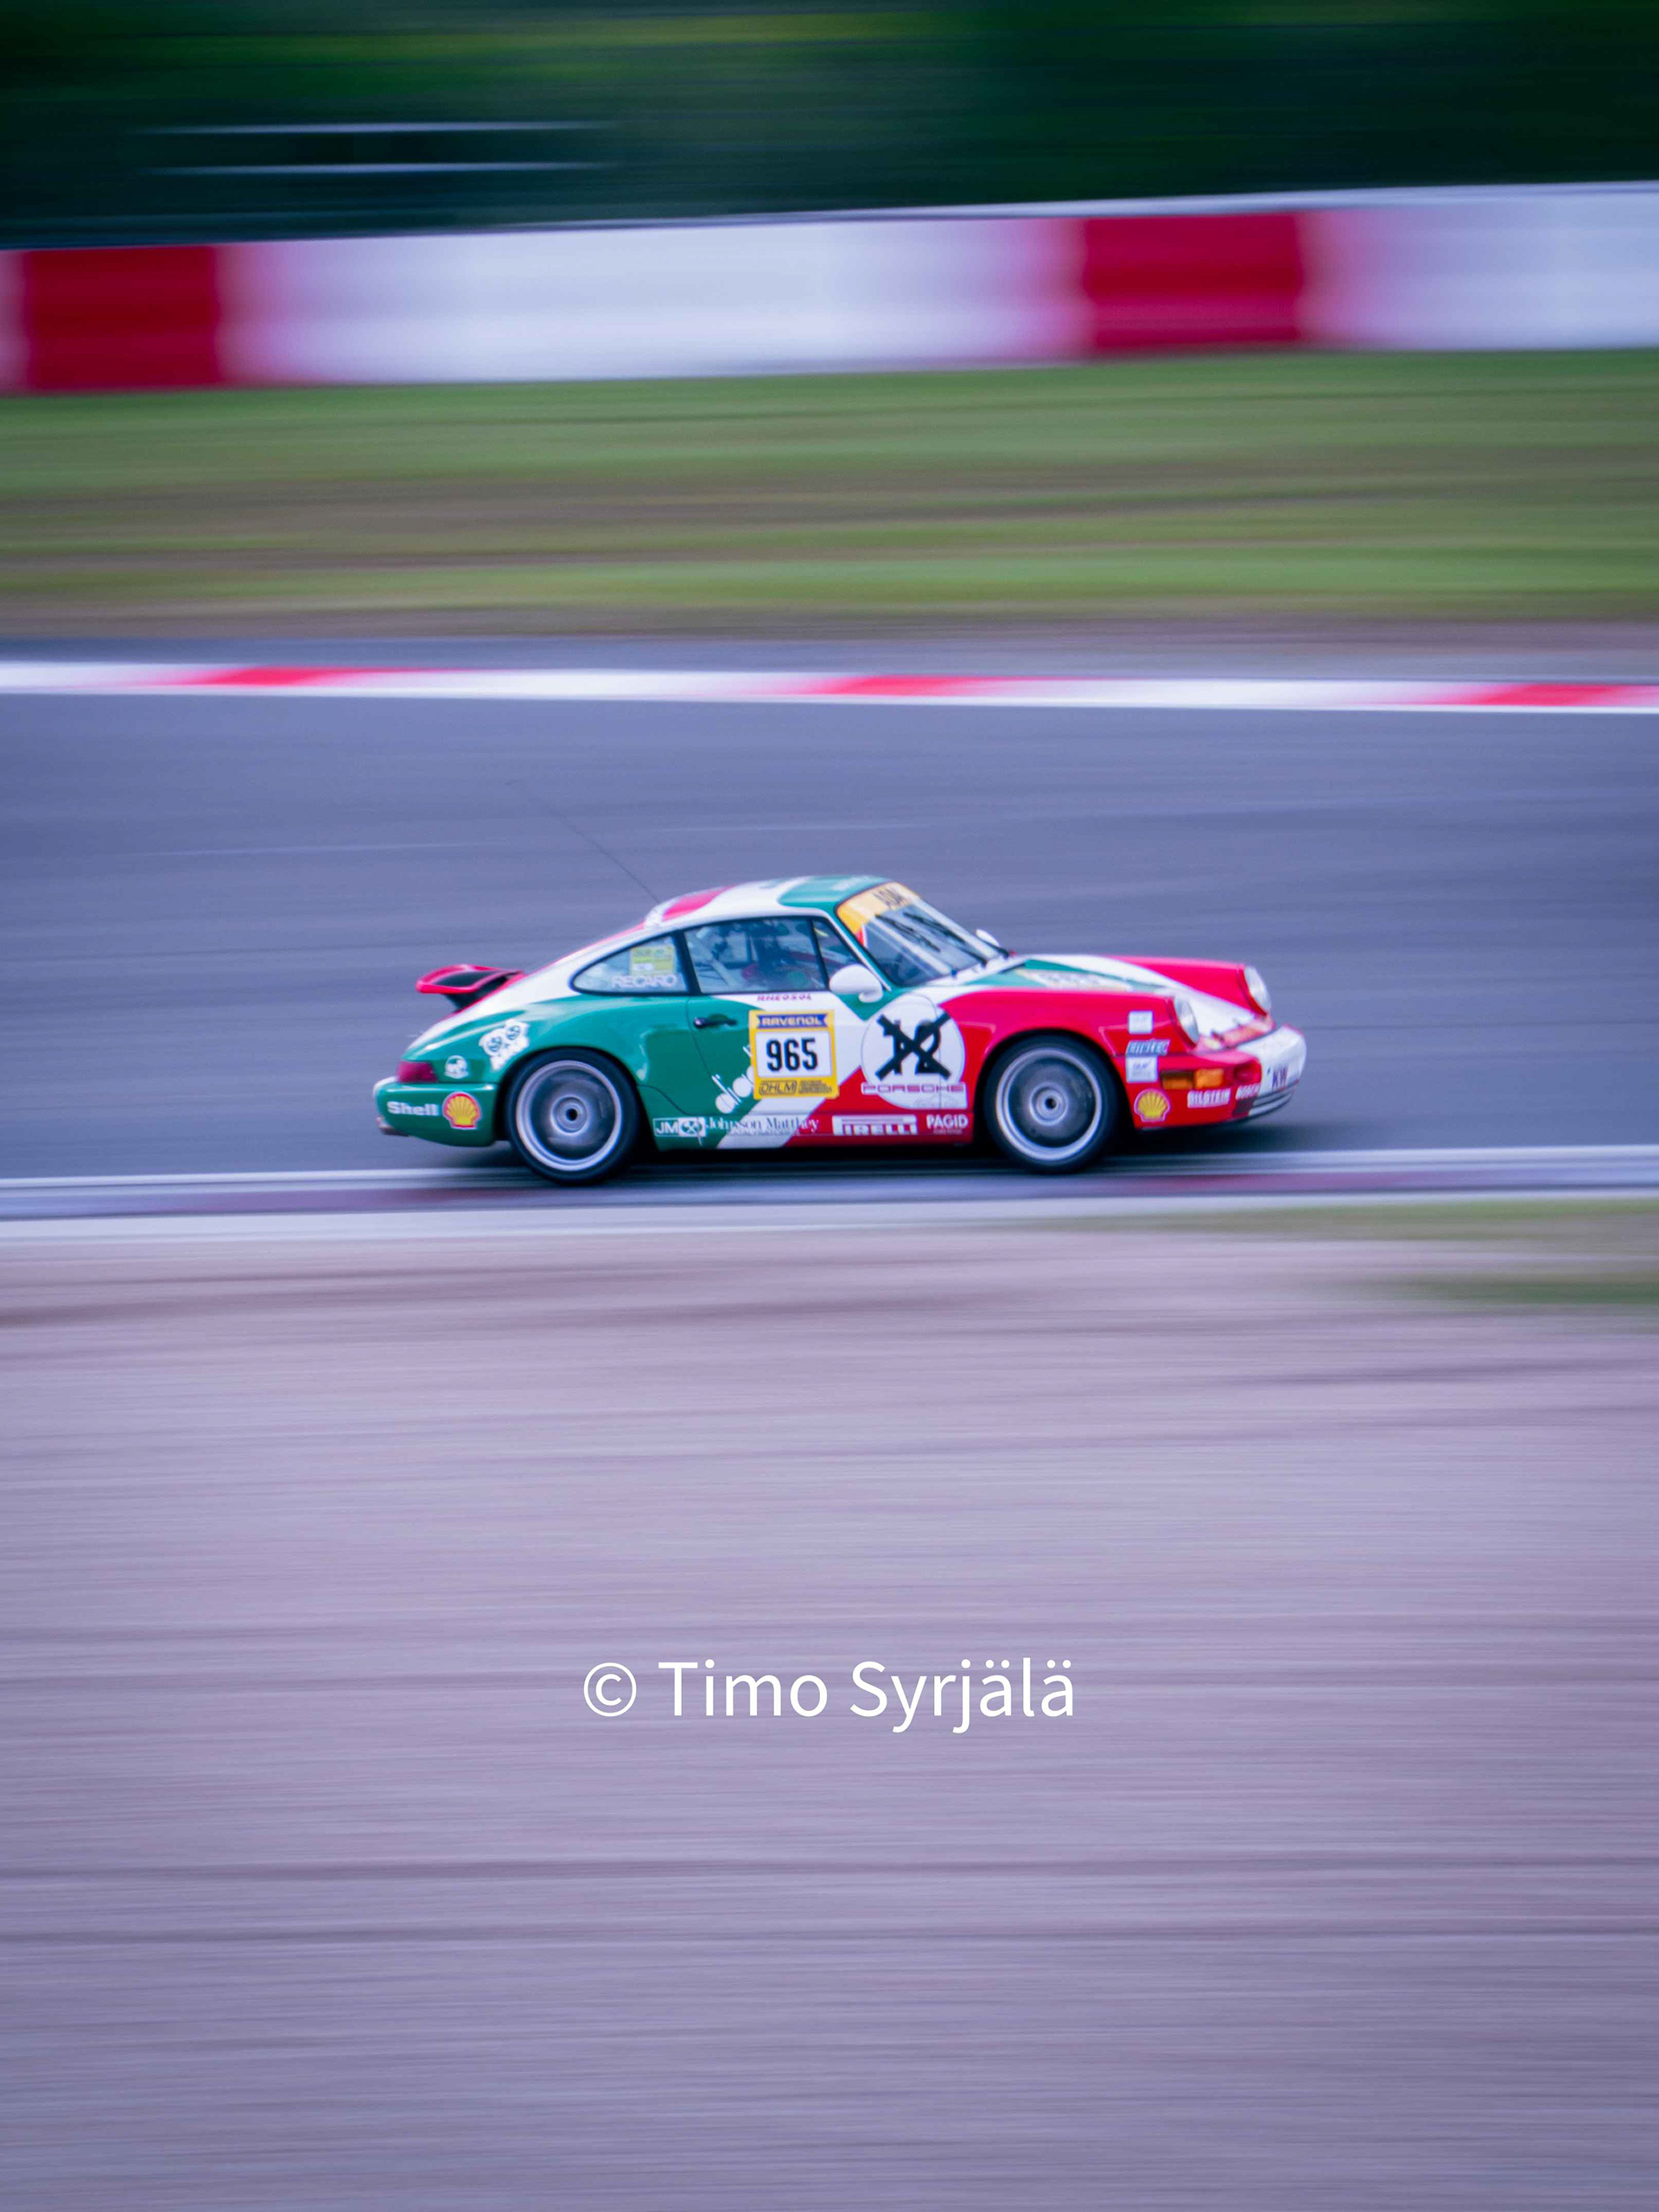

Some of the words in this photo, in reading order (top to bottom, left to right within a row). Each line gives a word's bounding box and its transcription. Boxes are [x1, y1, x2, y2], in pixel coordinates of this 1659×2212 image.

[612, 975, 677, 988] RECARO
[762, 1015, 823, 1026] RAVENOL
[766, 1037, 818, 1072] 965
[760, 1081, 796, 1094] DHLM
[863, 1084, 964, 1093] PORSCHE
[386, 1101, 439, 1116] Shell
[706, 1116, 763, 1130] Johnson
[766, 1116, 819, 1134] Matthey
[832, 1115, 918, 1136] PIRELLI
[926, 1114, 969, 1128] PAGID
[655, 1122, 678, 1135] JM
